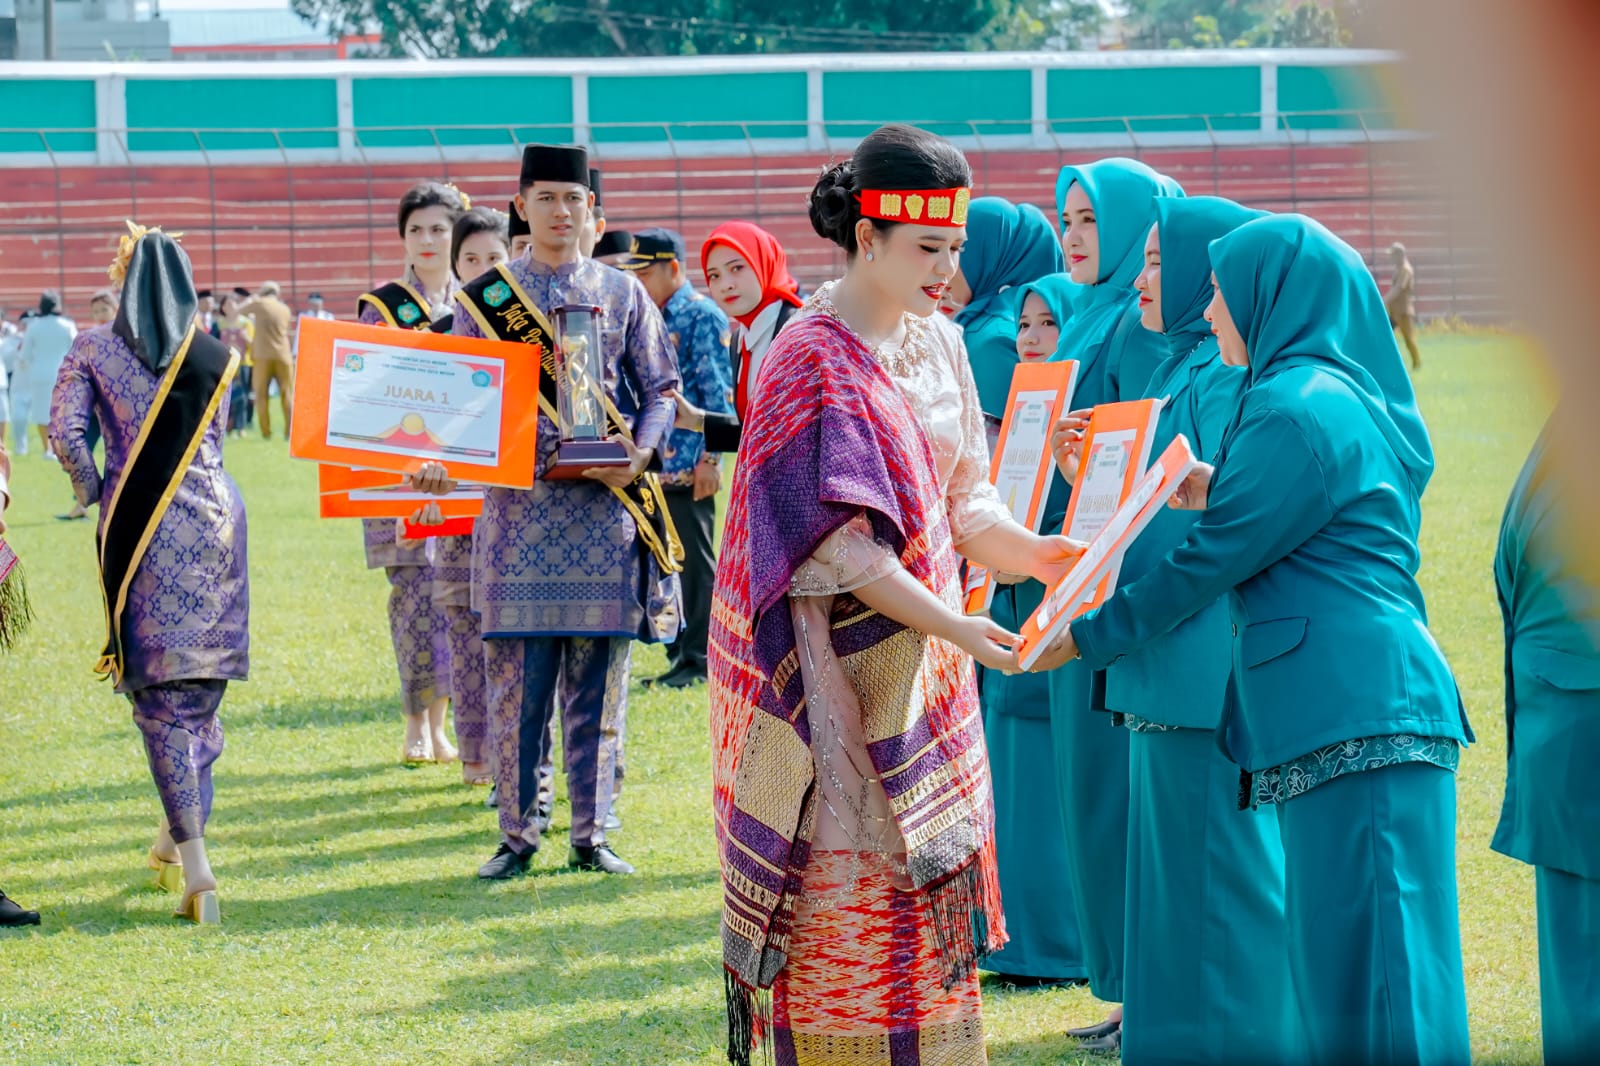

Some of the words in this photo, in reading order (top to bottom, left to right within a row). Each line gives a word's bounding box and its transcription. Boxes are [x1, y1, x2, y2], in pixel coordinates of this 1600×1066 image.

[496, 303, 531, 332] Jaka
[383, 384, 435, 403] JUARA
[441, 391, 450, 405] 1
